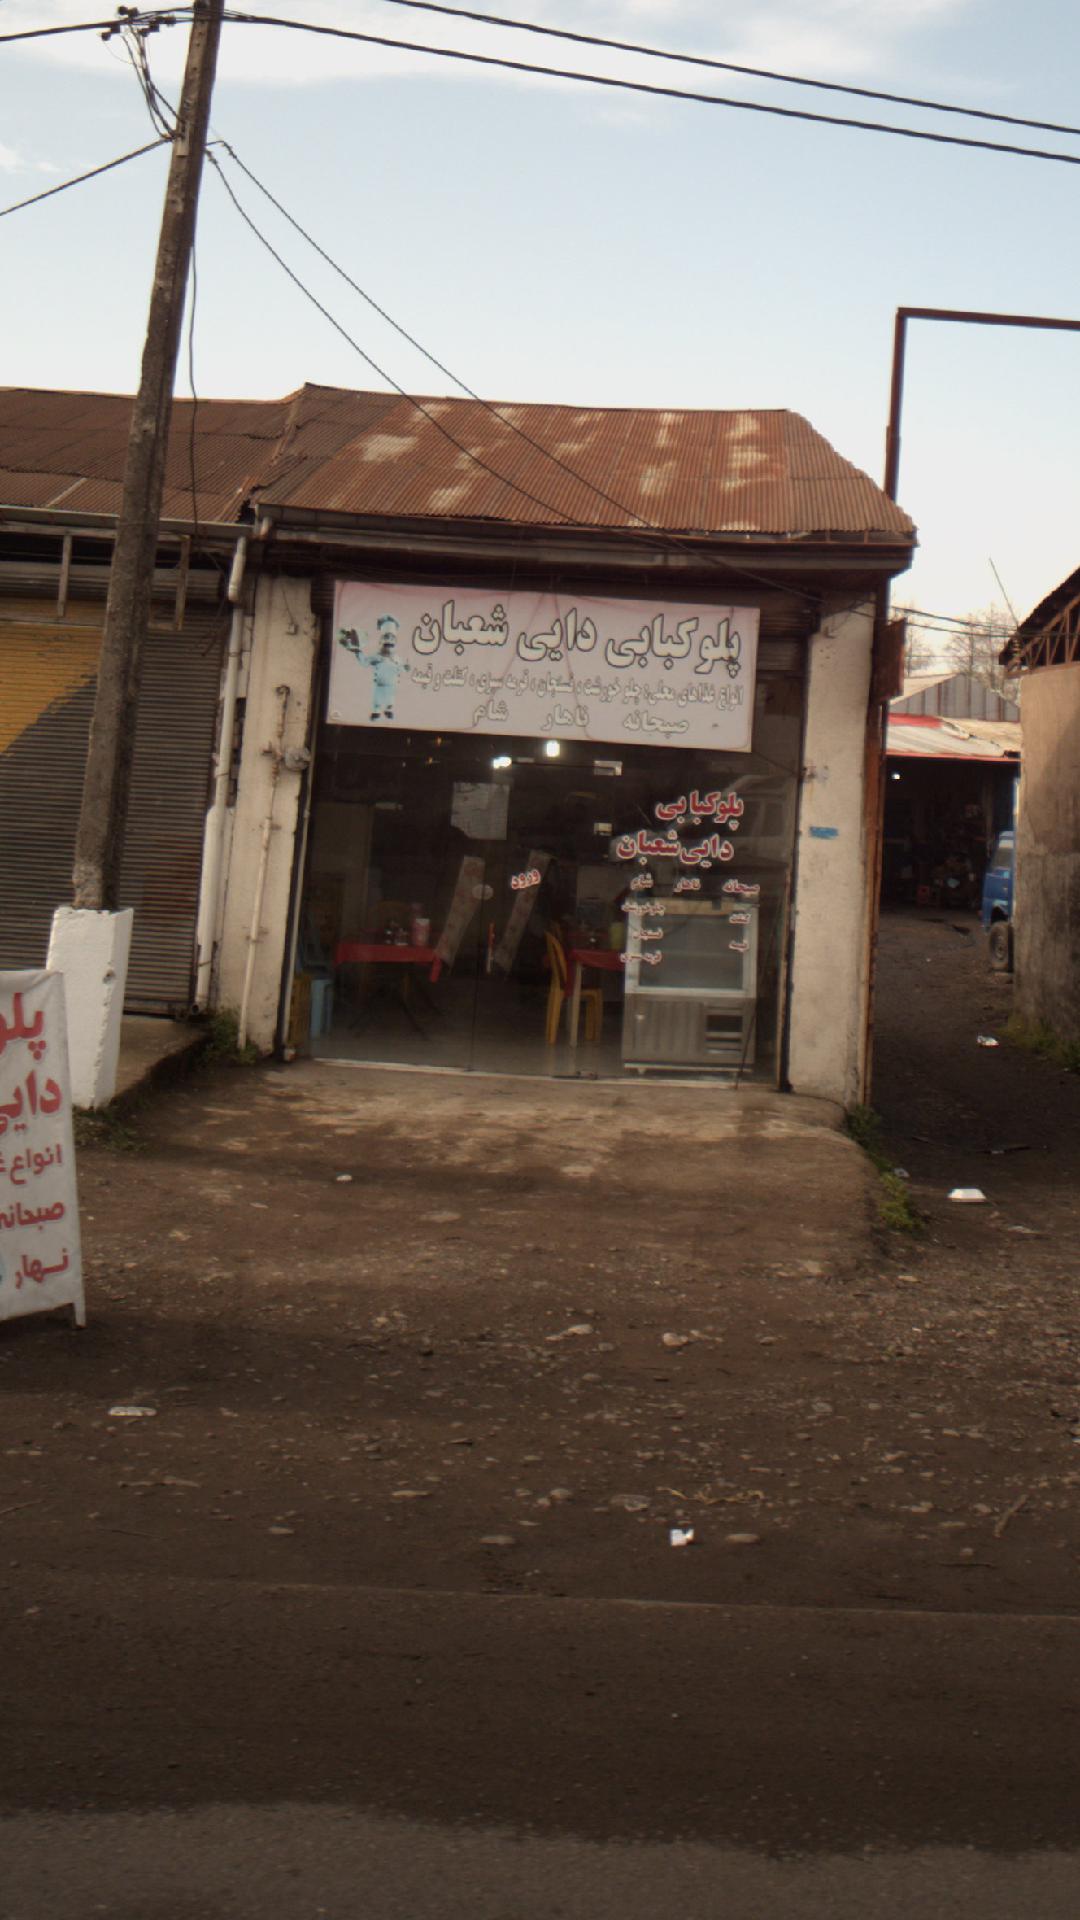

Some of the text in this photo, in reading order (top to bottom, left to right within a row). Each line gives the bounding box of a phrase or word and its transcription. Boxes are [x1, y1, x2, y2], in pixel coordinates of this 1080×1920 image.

[412, 599, 509, 656] شعبان
[516, 607, 598, 662] دایی
[472, 698, 690, 740] صبحانه ناهار شام
[616, 829, 735, 868] دایی شعبان
[511, 868, 542, 890] ورود
[10, 1143, 63, 1186] انواع
[15, 1247, 70, 1290] نهار
